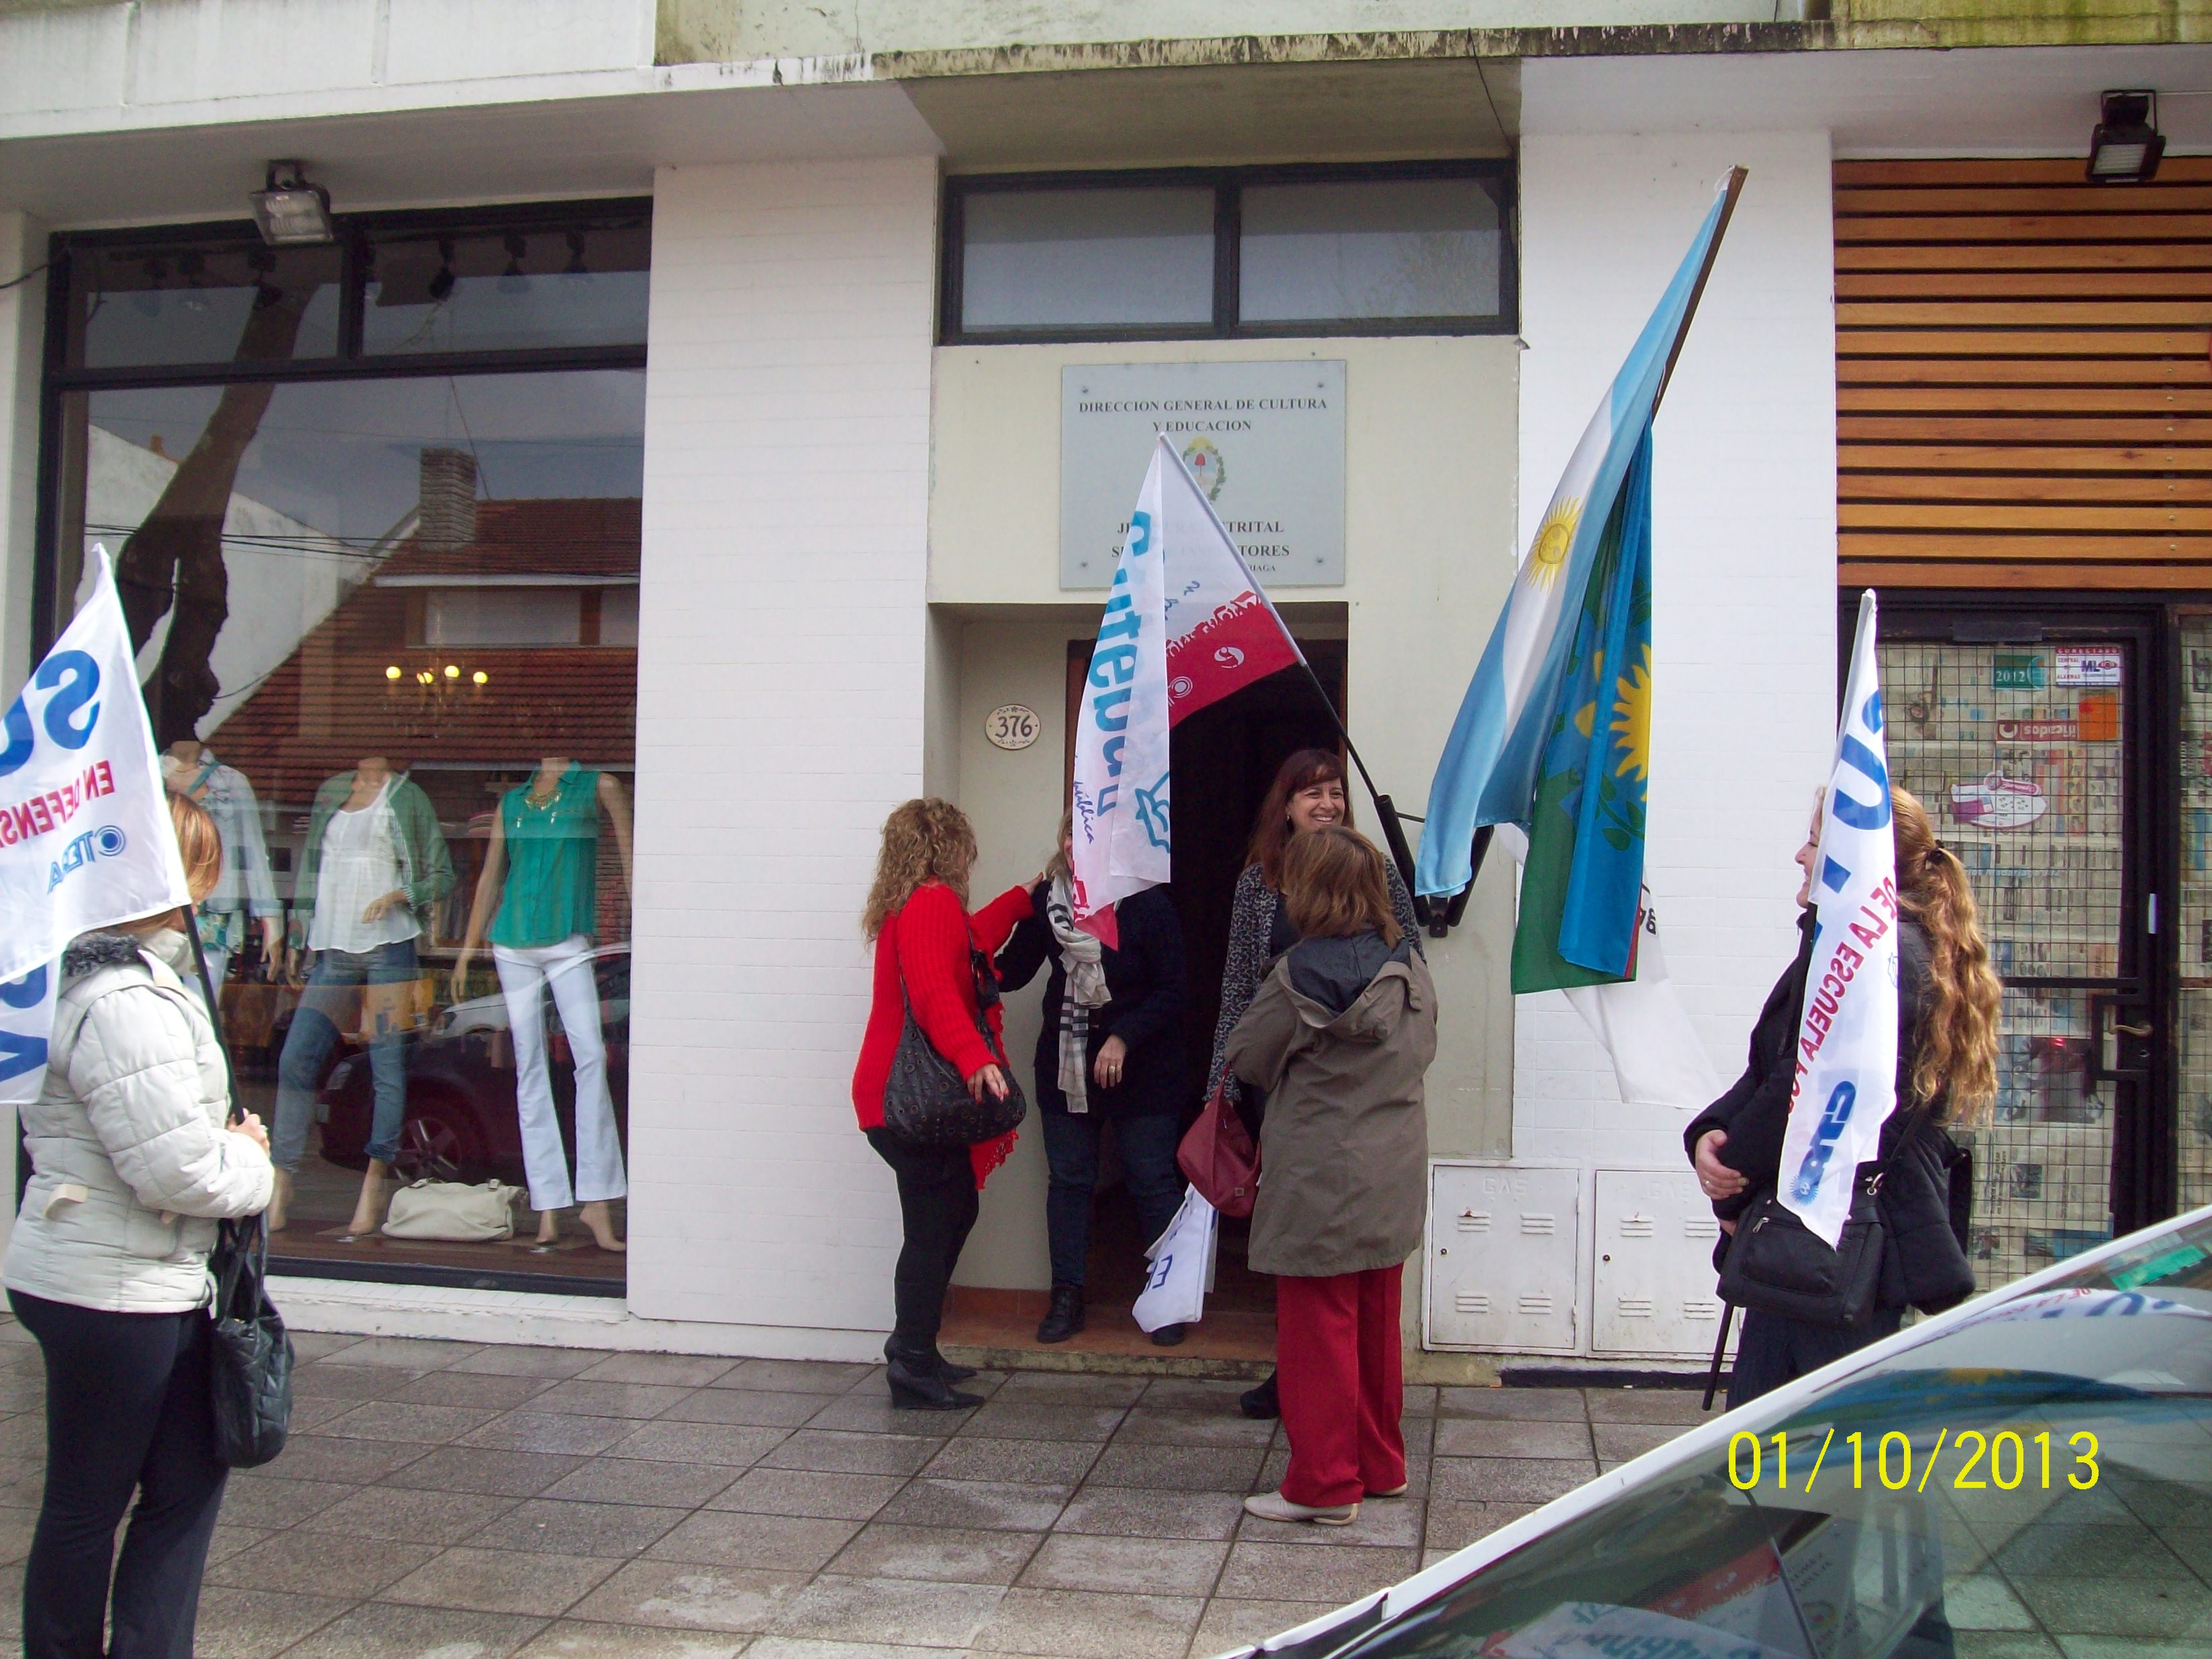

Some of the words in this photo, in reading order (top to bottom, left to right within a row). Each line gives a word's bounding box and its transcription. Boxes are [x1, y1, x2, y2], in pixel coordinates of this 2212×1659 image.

[1079, 401, 1159, 413] DIRECCION
[1163, 399, 1232, 411] GENERAL
[1236, 399, 1254, 410] DE
[1259, 398, 1327, 410] CULTURA
[1153, 421, 1161, 432] Y
[1166, 420, 1252, 432] EDUCACION
[1996, 670, 2025, 683] 2012
[995, 715, 1032, 738] 376
[1482, 1177, 1529, 1195] GAS
